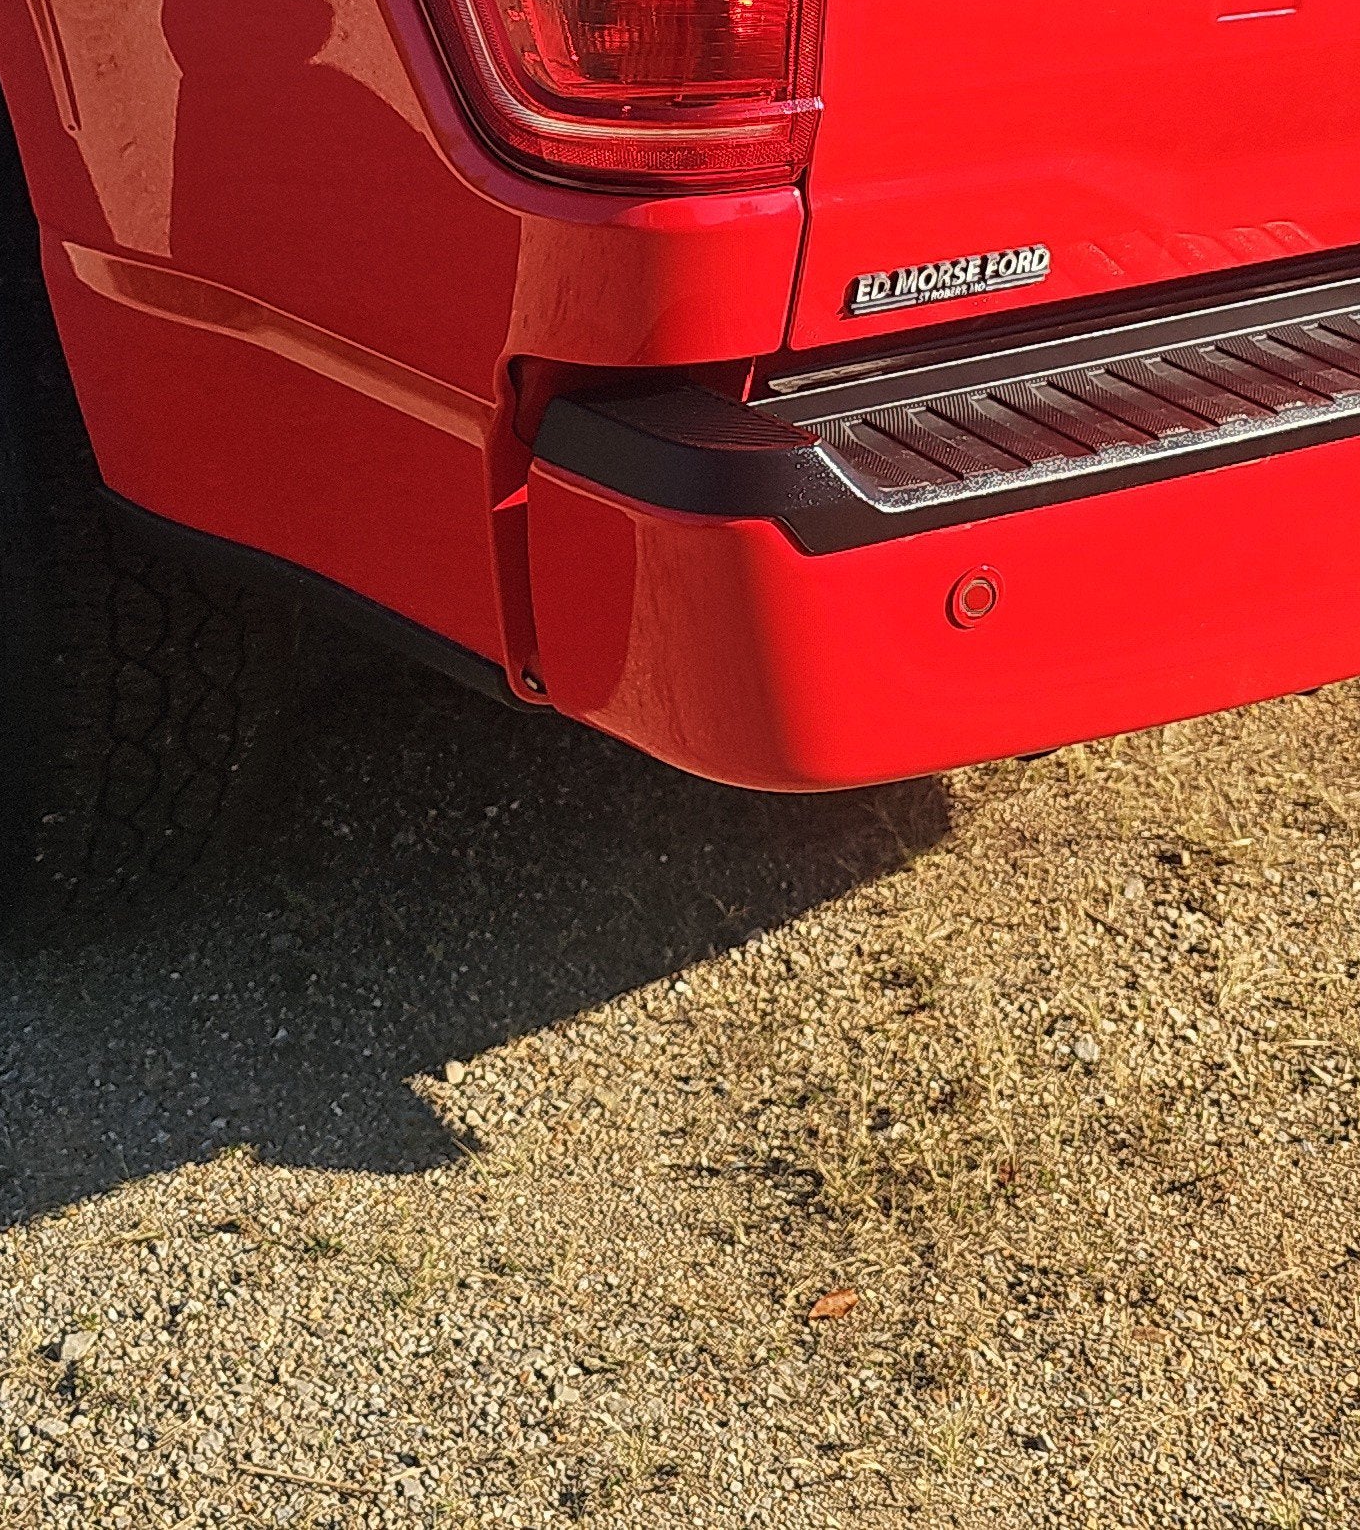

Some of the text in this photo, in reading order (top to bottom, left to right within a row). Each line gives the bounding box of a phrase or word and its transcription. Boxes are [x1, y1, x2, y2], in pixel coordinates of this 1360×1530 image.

[856, 244, 1051, 303] ED MORSE FORD
